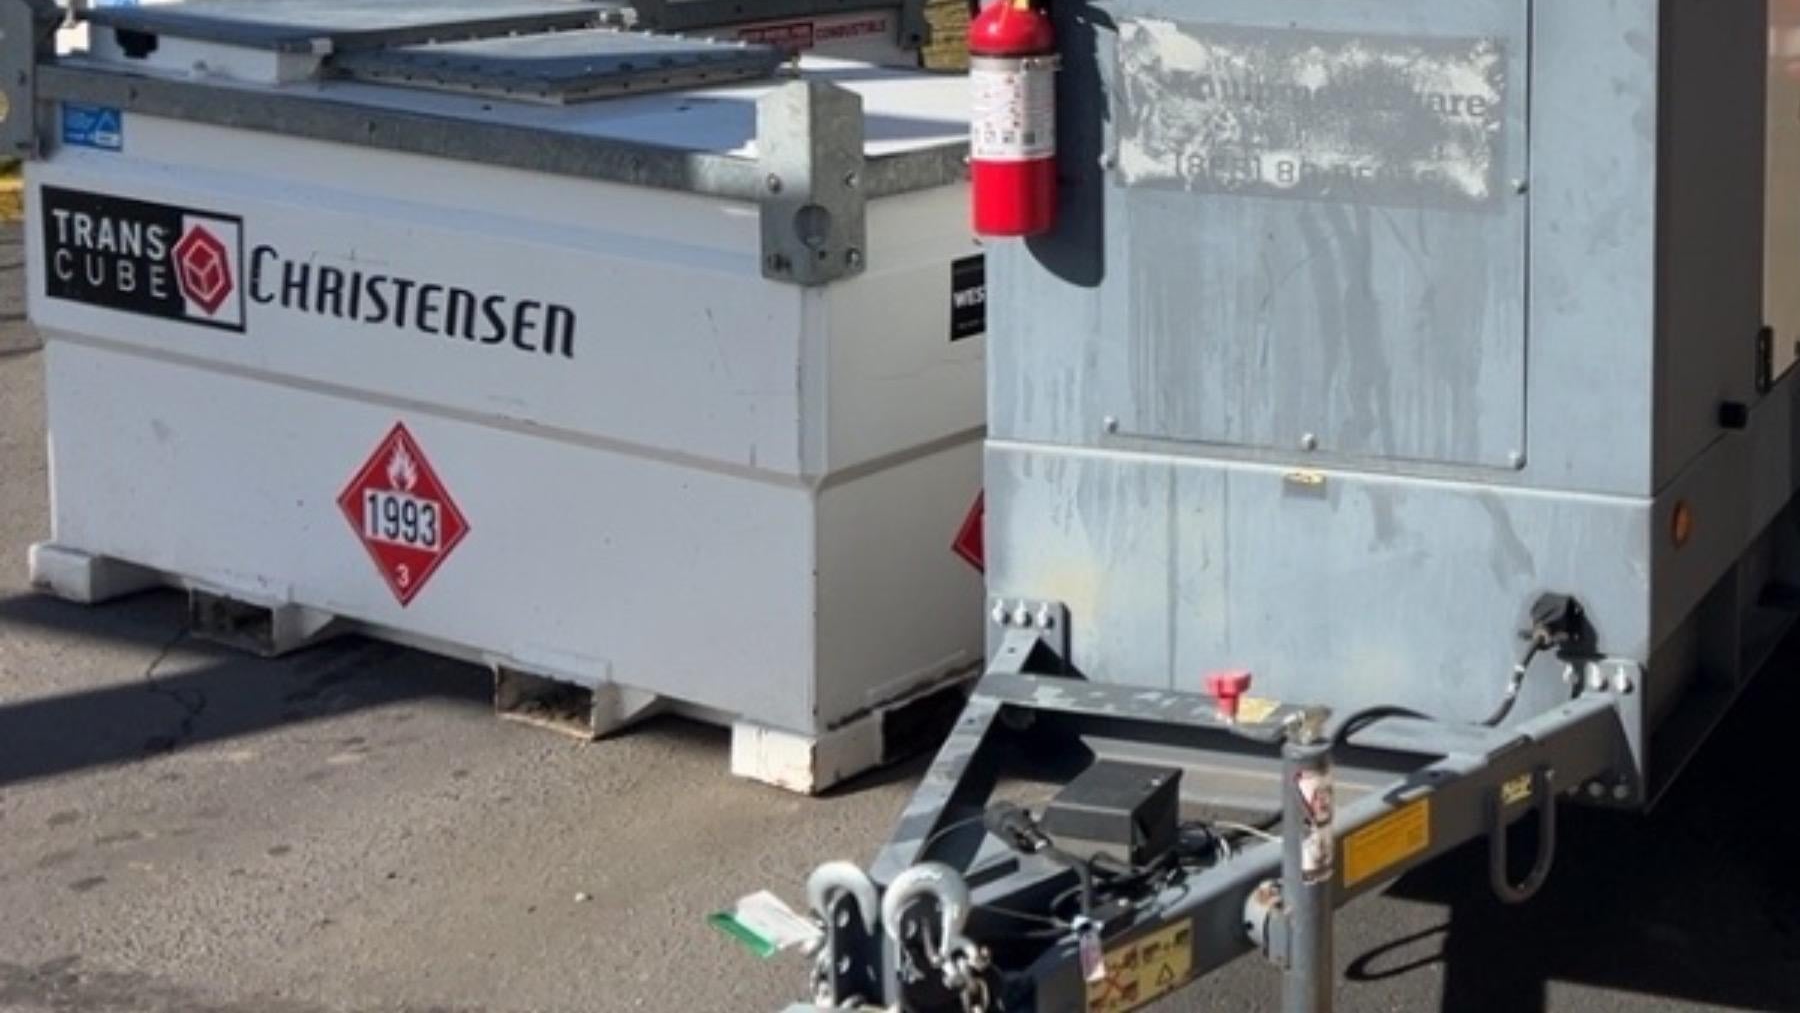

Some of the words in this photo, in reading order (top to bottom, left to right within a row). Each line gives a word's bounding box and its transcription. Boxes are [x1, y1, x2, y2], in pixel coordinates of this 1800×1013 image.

[52, 208, 167, 261] TRANS
[53, 248, 168, 300] CUBE
[368, 493, 437, 547] 1993
[395, 562, 410, 587] 3
